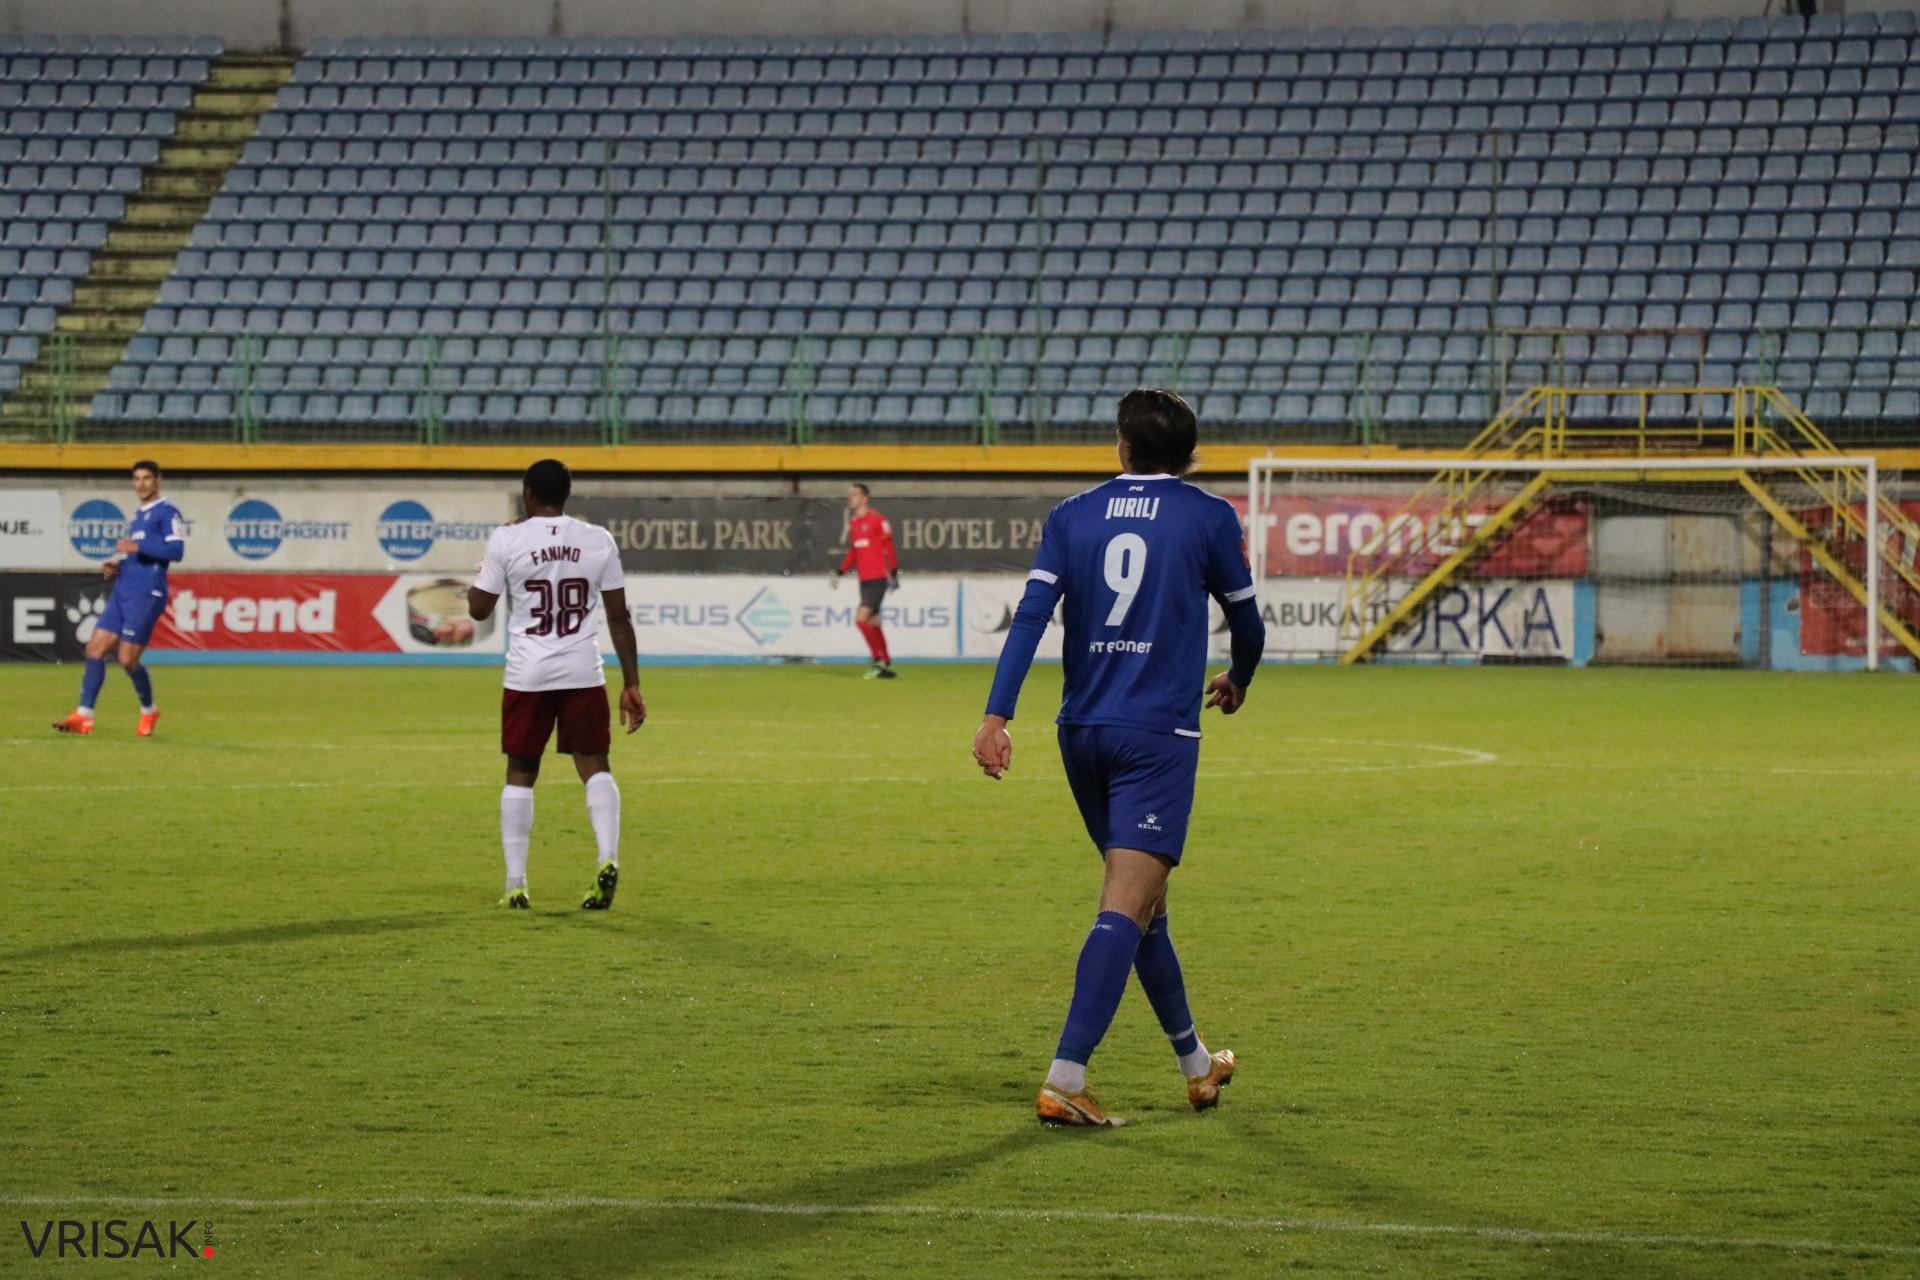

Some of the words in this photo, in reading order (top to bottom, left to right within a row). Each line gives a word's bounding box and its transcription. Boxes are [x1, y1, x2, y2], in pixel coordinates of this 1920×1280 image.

[1105, 497, 1160, 520] JURILJ
[608, 519, 708, 550] HOTEL
[714, 519, 792, 549] PARK
[902, 519, 1003, 549] HOTEL
[1008, 519, 1043, 549] PA
[531, 546, 580, 565] FANIMO
[1103, 532, 1147, 626] 9
[173, 590, 337, 633] trend
[524, 578, 589, 638] 38
